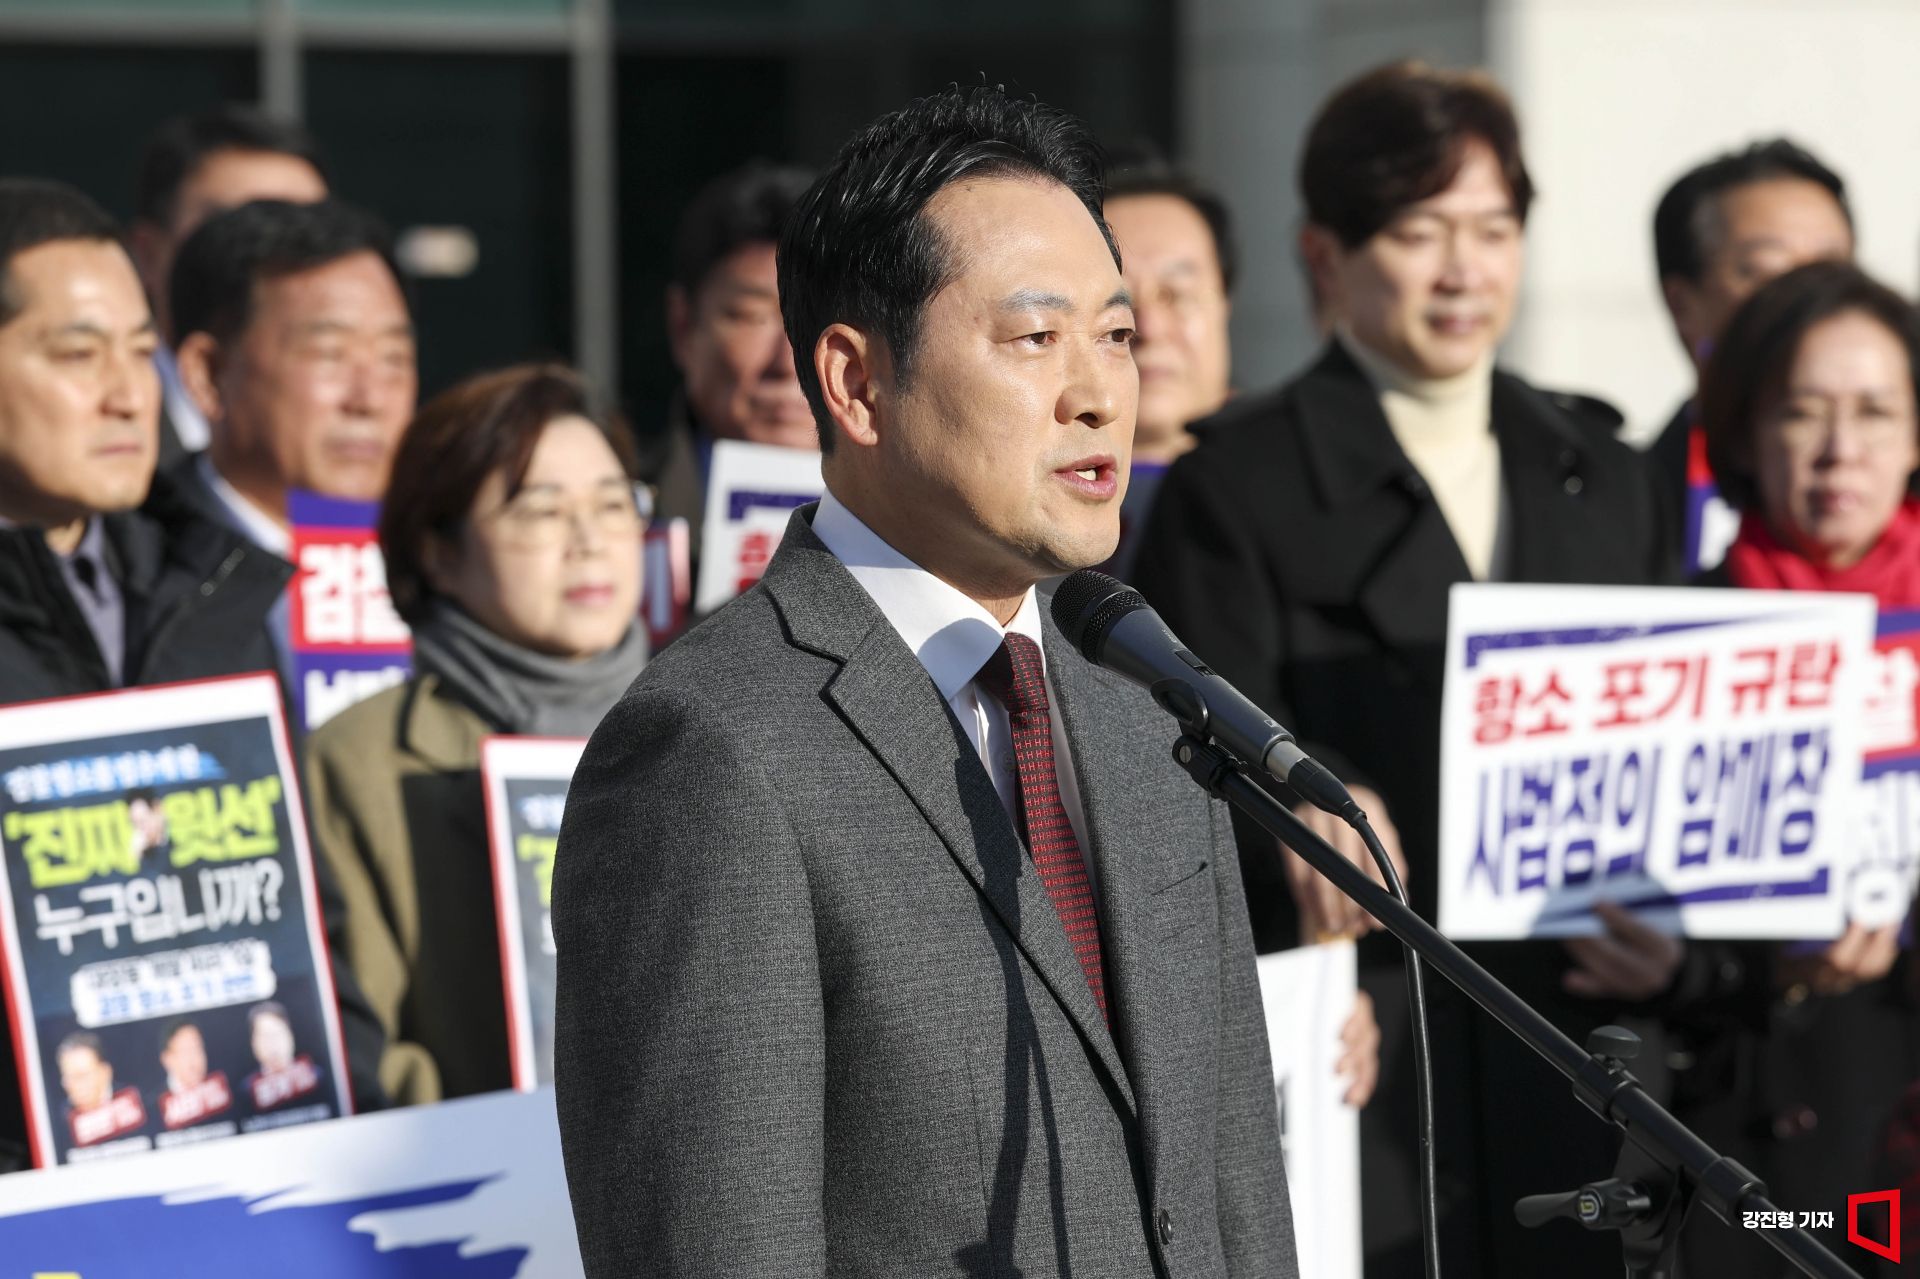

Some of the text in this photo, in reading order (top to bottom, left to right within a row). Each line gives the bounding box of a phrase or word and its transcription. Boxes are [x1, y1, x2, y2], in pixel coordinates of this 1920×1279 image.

[1472, 668, 1572, 747] 항소
[1591, 653, 1711, 731] 포기
[1729, 637, 1843, 715] 규탄
[1464, 745, 1663, 899] 사법정의
[1676, 726, 1833, 868] 암매장
[33, 856, 284, 956] 누구입니까?
